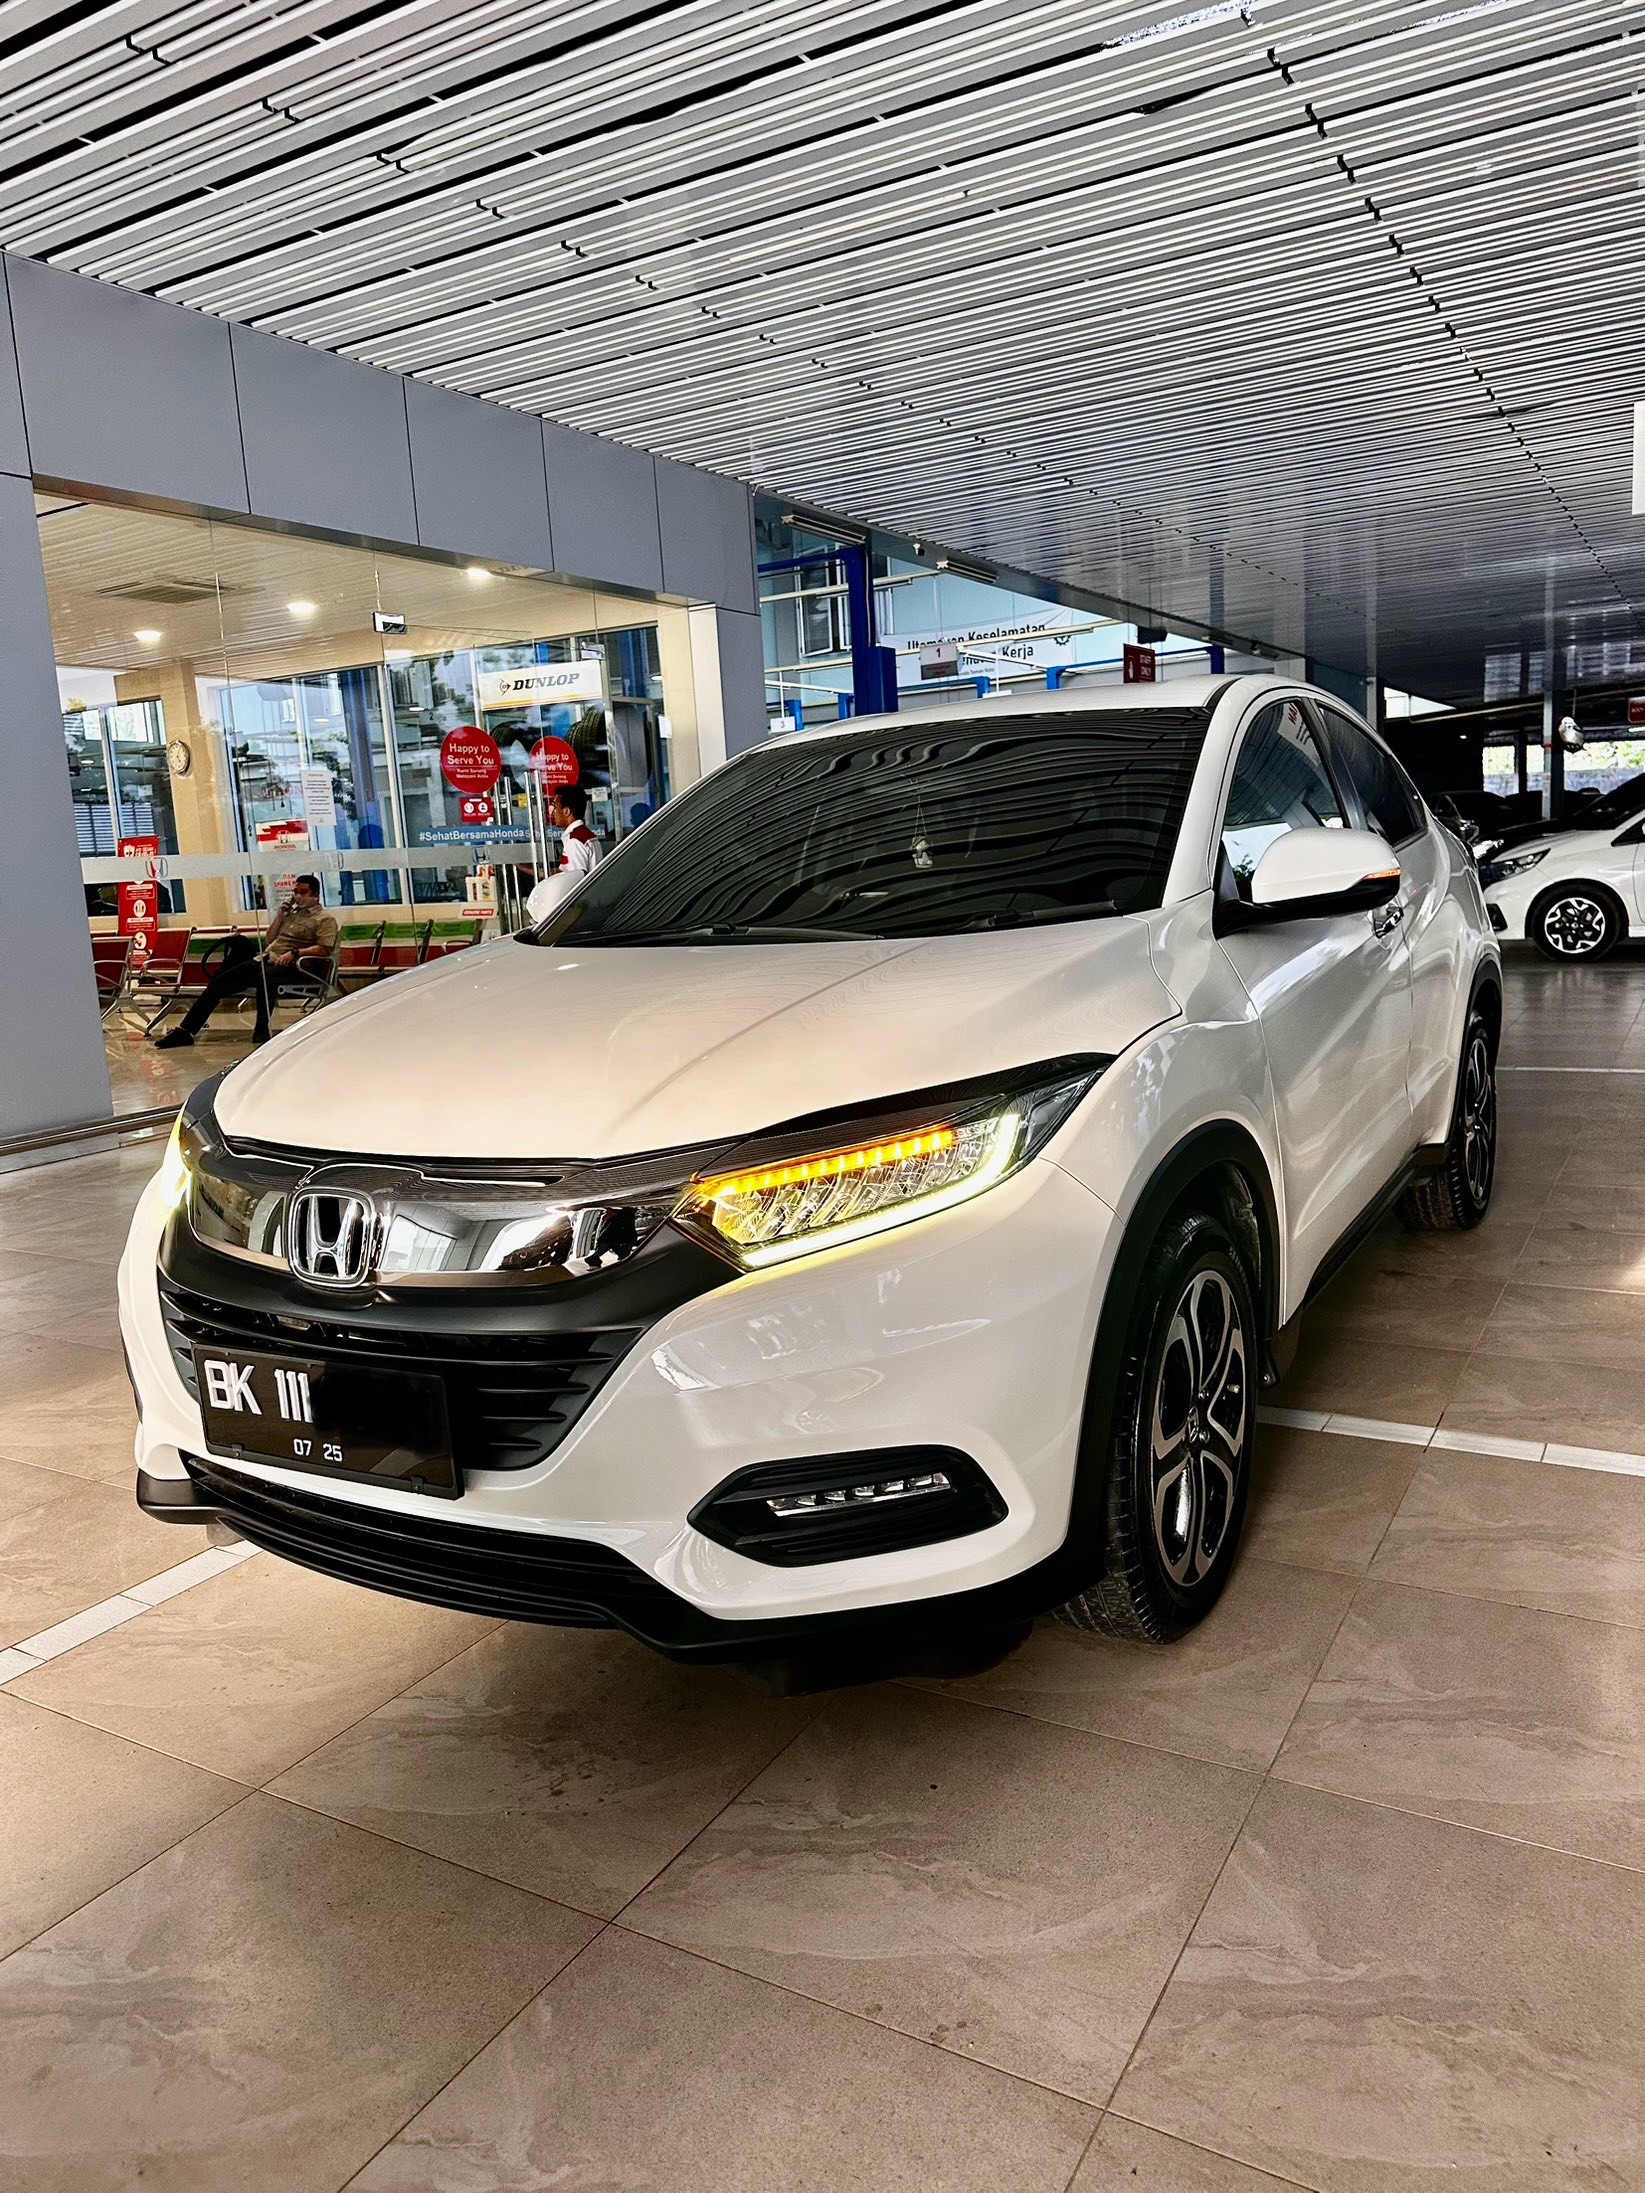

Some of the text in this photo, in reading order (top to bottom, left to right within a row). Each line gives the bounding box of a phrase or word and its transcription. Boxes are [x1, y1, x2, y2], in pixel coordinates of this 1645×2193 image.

[968, 623, 1046, 641] Keselamatan
[935, 647, 941, 657] 1
[1002, 645, 1034, 660] Kerja
[513, 672, 580, 690] DUNLOP
[449, 743, 490, 754] Happy to
[447, 755, 494, 765] Serve You
[536, 752, 569, 763] Happy to
[557, 762, 573, 771] You
[419, 826, 525, 842] #SehatBersamaHonda
[203, 1359, 262, 1415] BK
[293, 1438, 342, 1463] 07 25
